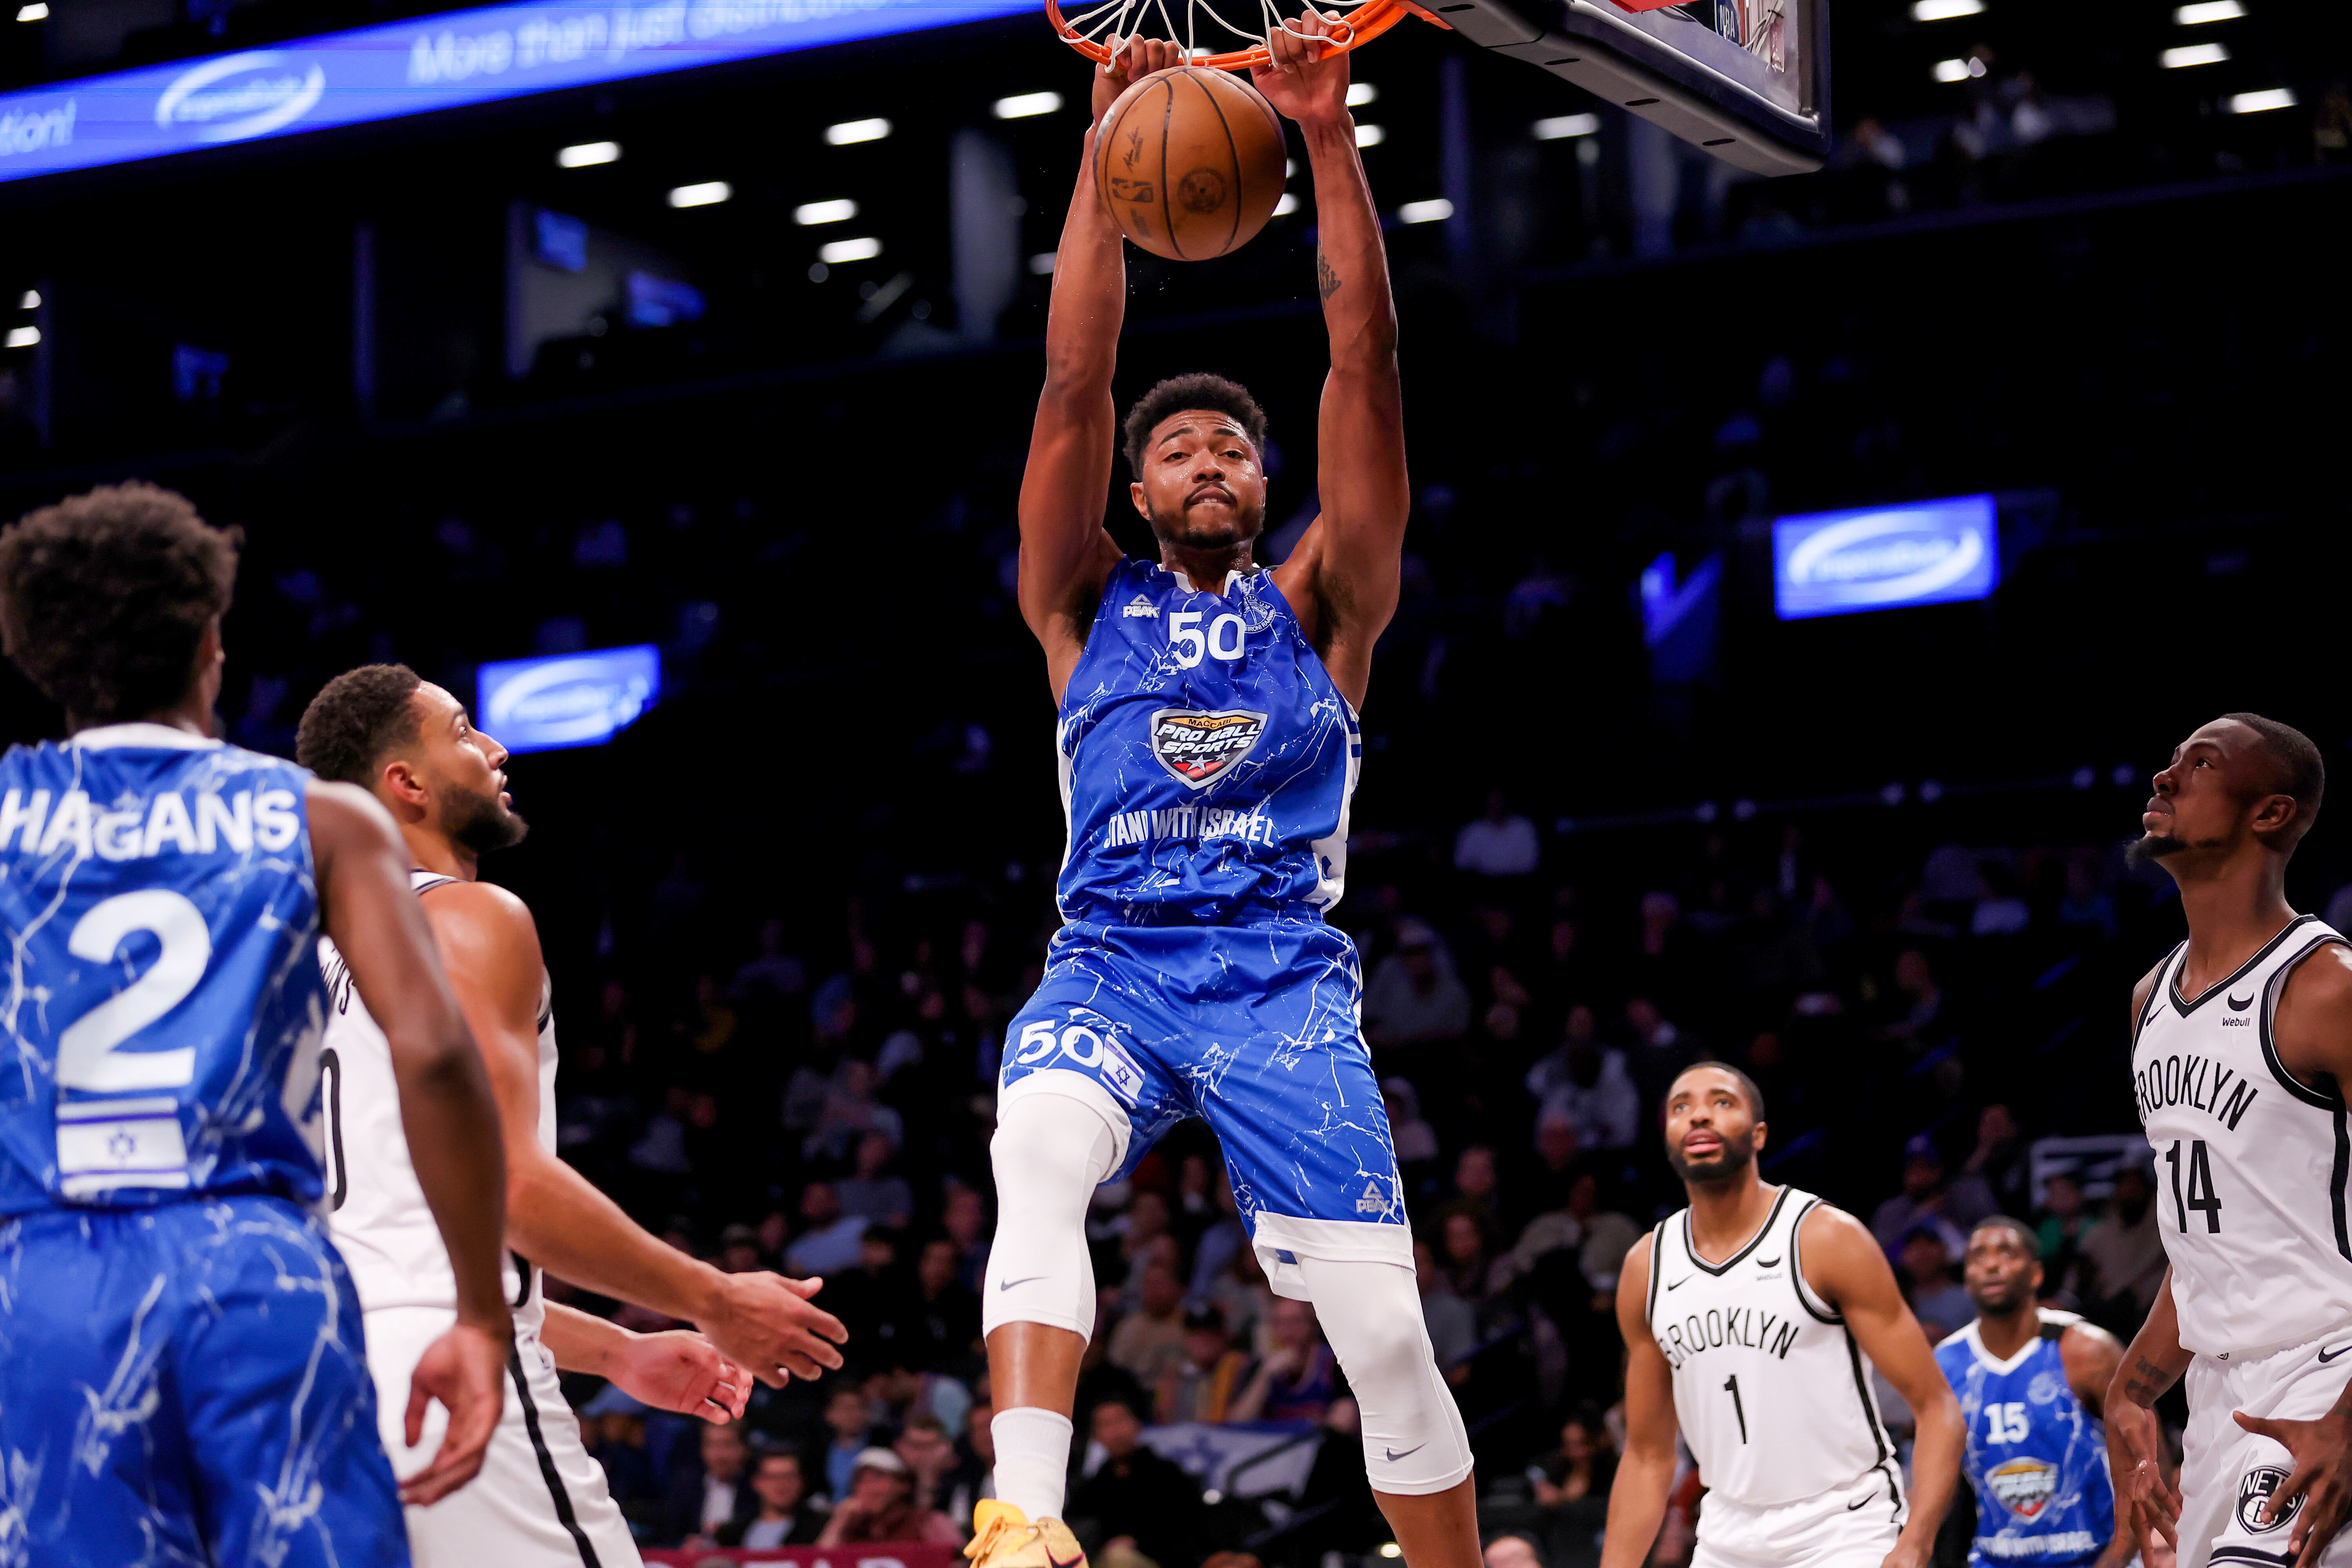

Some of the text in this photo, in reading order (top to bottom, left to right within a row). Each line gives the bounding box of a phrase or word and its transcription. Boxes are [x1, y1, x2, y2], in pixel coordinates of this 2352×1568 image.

[1719, 4, 1735, 38] NBA
[1123, 605, 1160, 618] PEAK
[1169, 611, 1246, 668] 50
[1156, 724, 1206, 742] PRO
[1159, 735, 1255, 754] SPORTS
[1188, 718, 1232, 729] MACCABI
[0, 789, 299, 862] HAGANS
[1151, 806, 1198, 840] WITH
[1199, 806, 1274, 849] ISRAEL
[56, 888, 210, 1093] 2
[2222, 1017, 2250, 1027] Webull
[1018, 1020, 1105, 1068] 50
[2136, 1054, 2258, 1132] ROOKLYN
[2166, 1140, 2222, 1234] 14
[1725, 1374, 1747, 1445] 1
[1984, 1402, 2031, 1445] 15
[2240, 1470, 2296, 1509] NET
